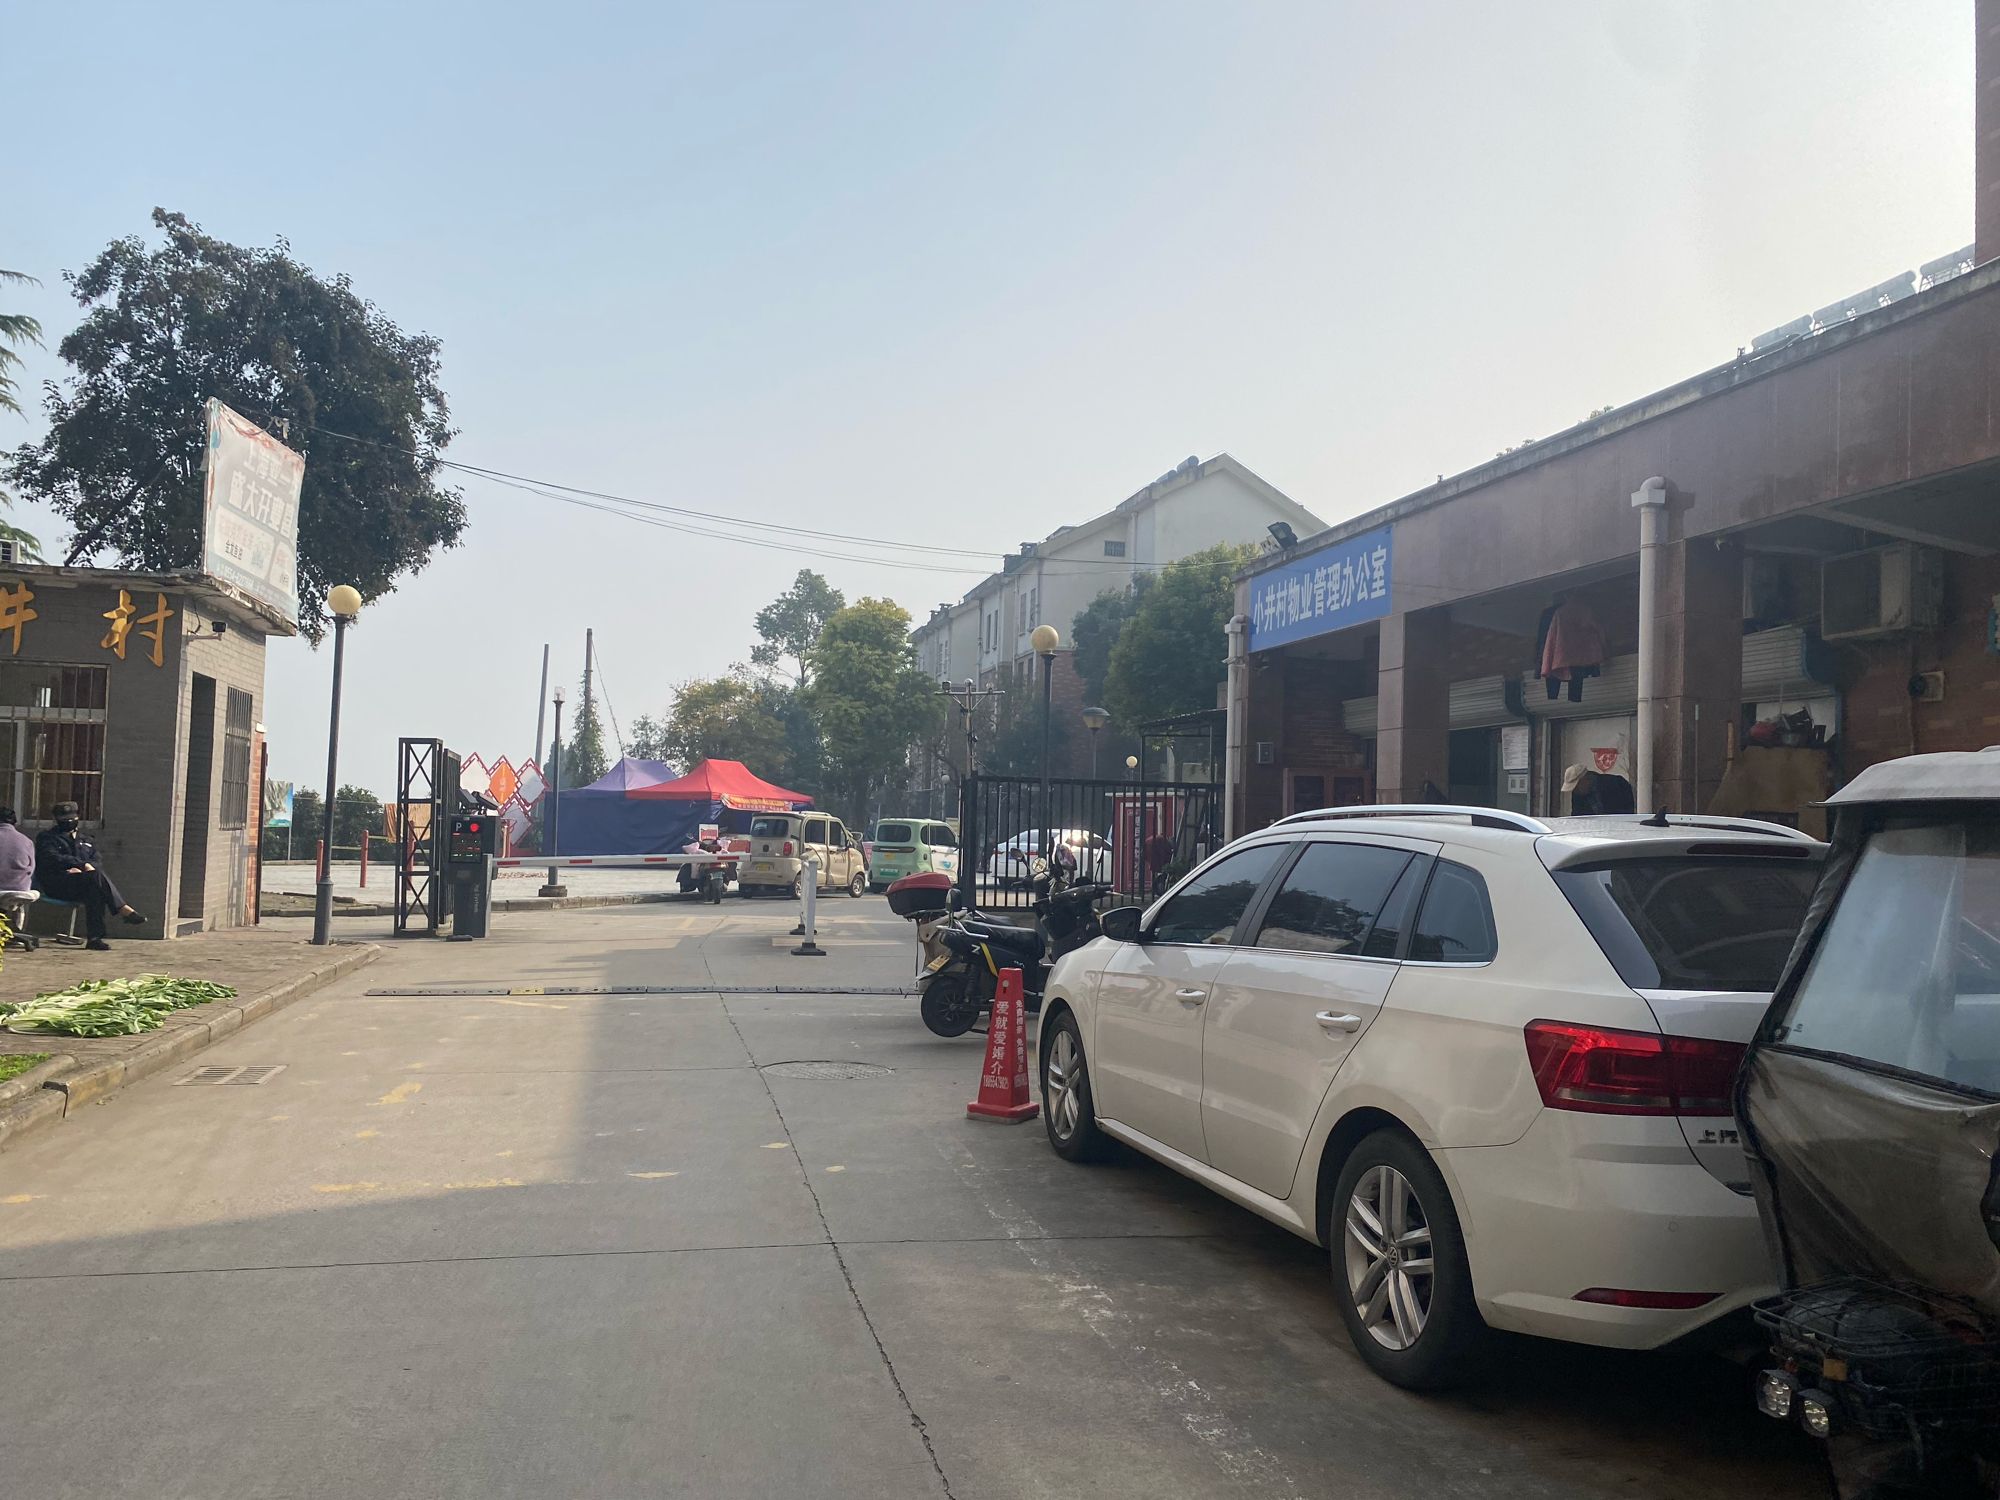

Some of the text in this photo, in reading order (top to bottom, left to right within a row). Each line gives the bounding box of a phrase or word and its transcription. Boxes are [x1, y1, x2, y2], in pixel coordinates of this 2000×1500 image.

[1253, 545, 1387, 634] 小井村物业管理办公室
[990, 1000, 1010, 1075] 爱就爱婚介
